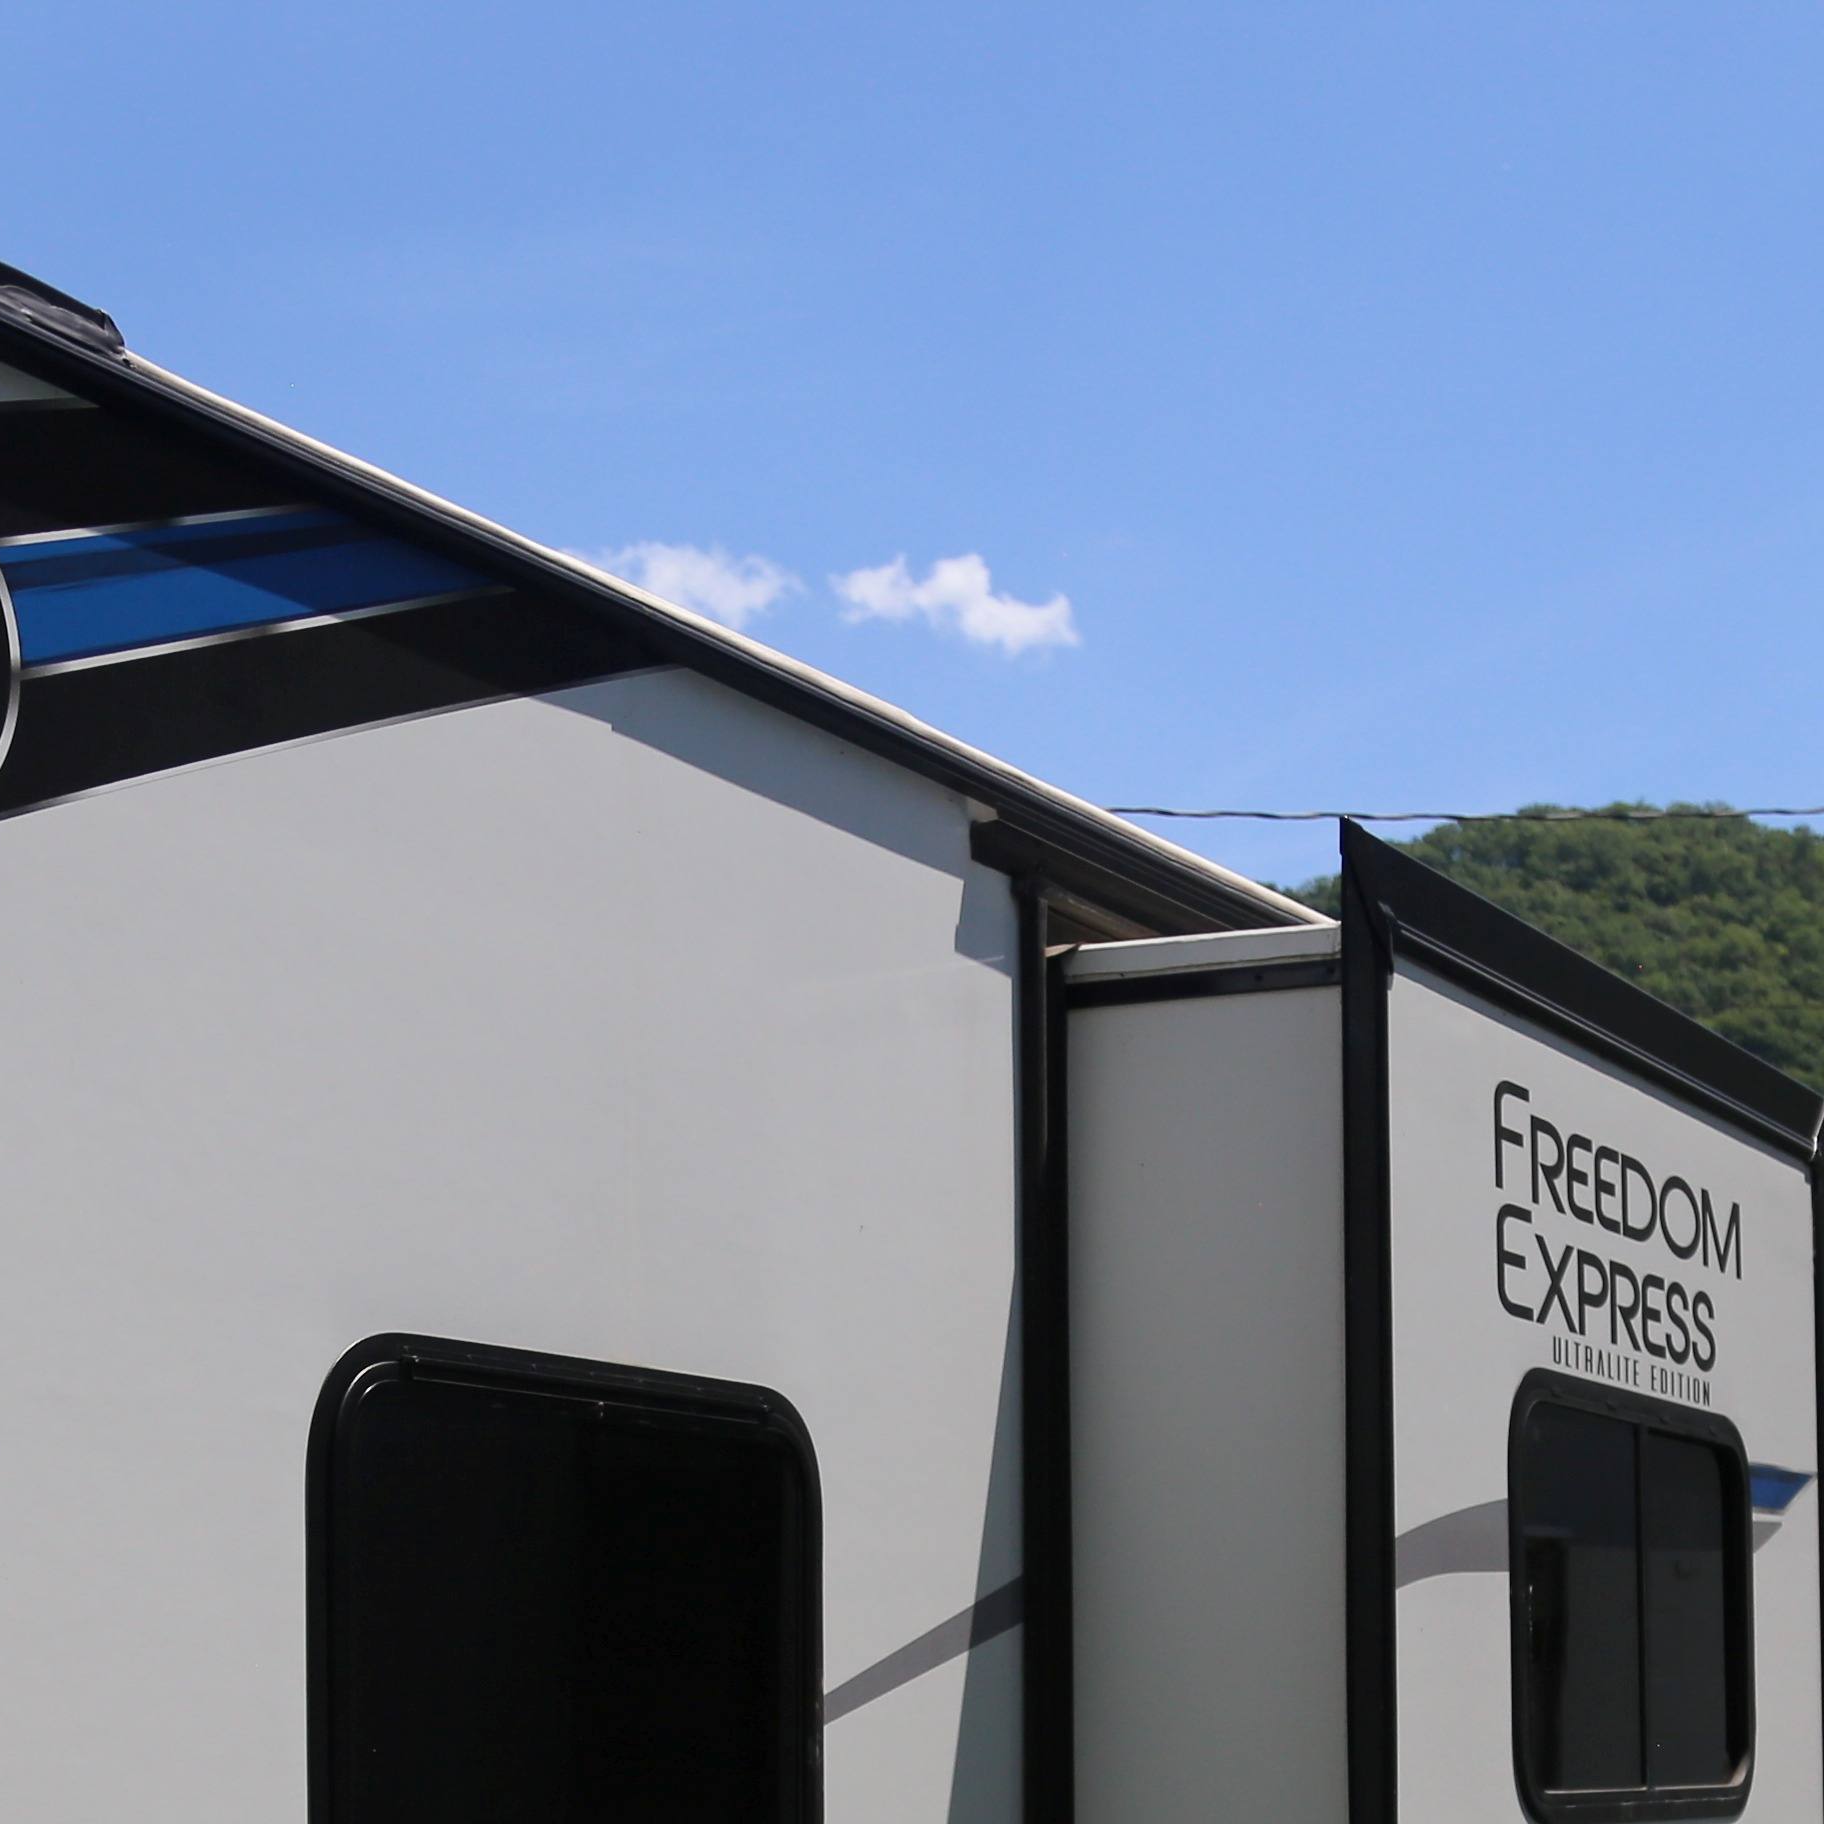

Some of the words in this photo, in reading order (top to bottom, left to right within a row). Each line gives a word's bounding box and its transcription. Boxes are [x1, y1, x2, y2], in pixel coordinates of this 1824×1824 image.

[1493, 1079, 1743, 1280] FREEDOM
[1496, 1203, 1716, 1373] EXPRESS
[1552, 1335, 1640, 1388] ULTRALITE
[1650, 1364, 1711, 1407] EDITION
